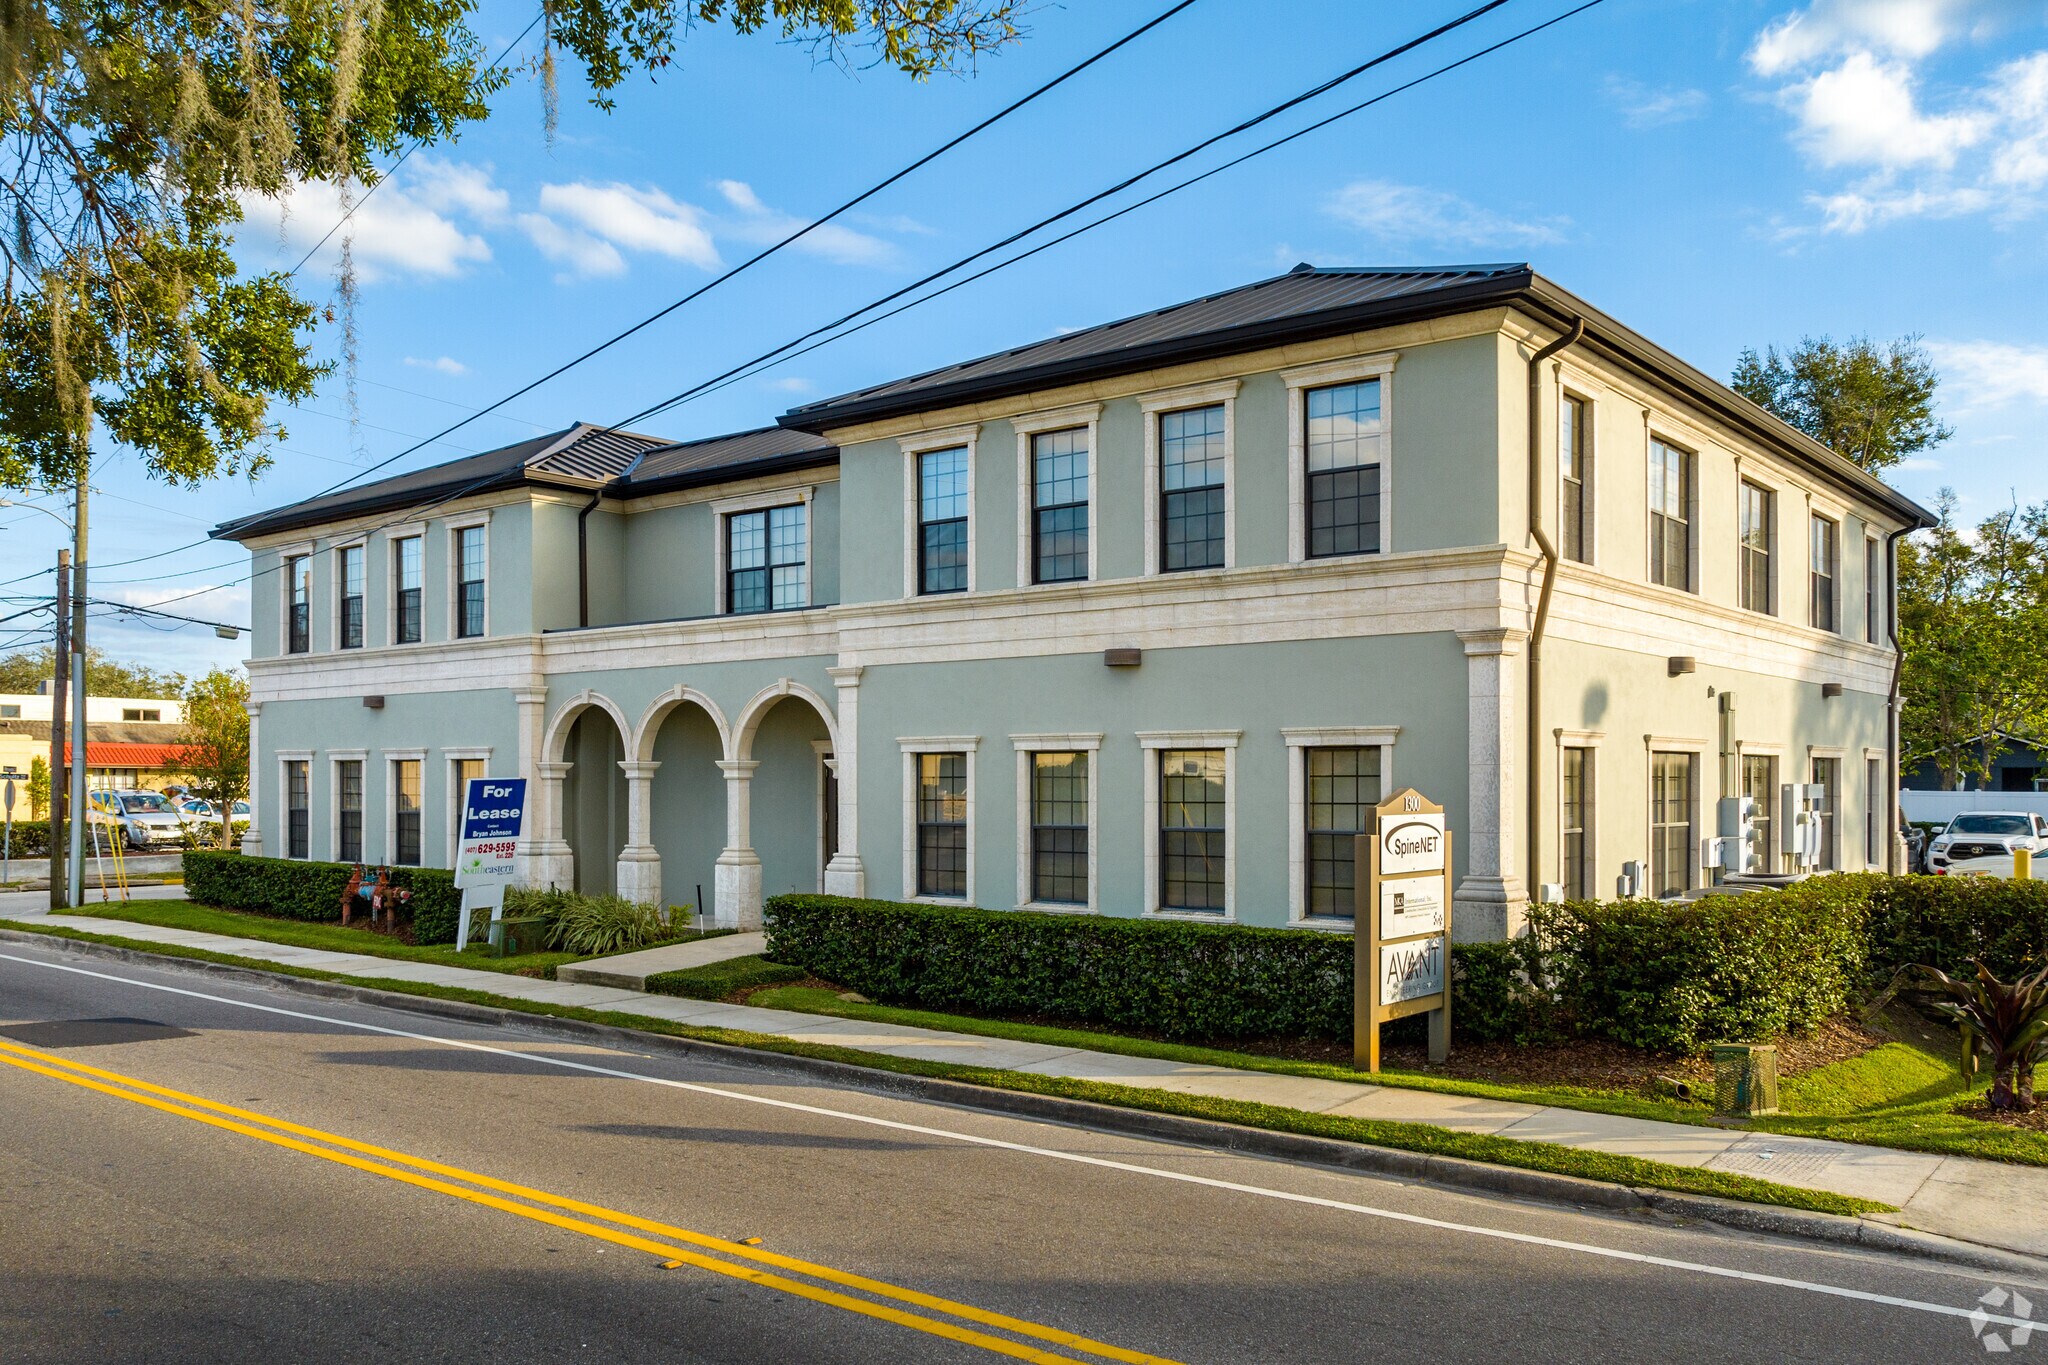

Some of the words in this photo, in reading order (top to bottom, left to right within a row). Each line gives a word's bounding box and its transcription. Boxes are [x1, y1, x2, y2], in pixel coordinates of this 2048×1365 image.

[482, 785, 513, 798] For
[1404, 796, 1420, 811] 1300
[468, 807, 521, 820] Lease
[472, 830, 488, 838] Bryan
[477, 842, 516, 854] 629-5595
[1394, 836, 1438, 859] SpineNET
[463, 864, 514, 875] Southeastern
[1386, 946, 1440, 985] AVANT
